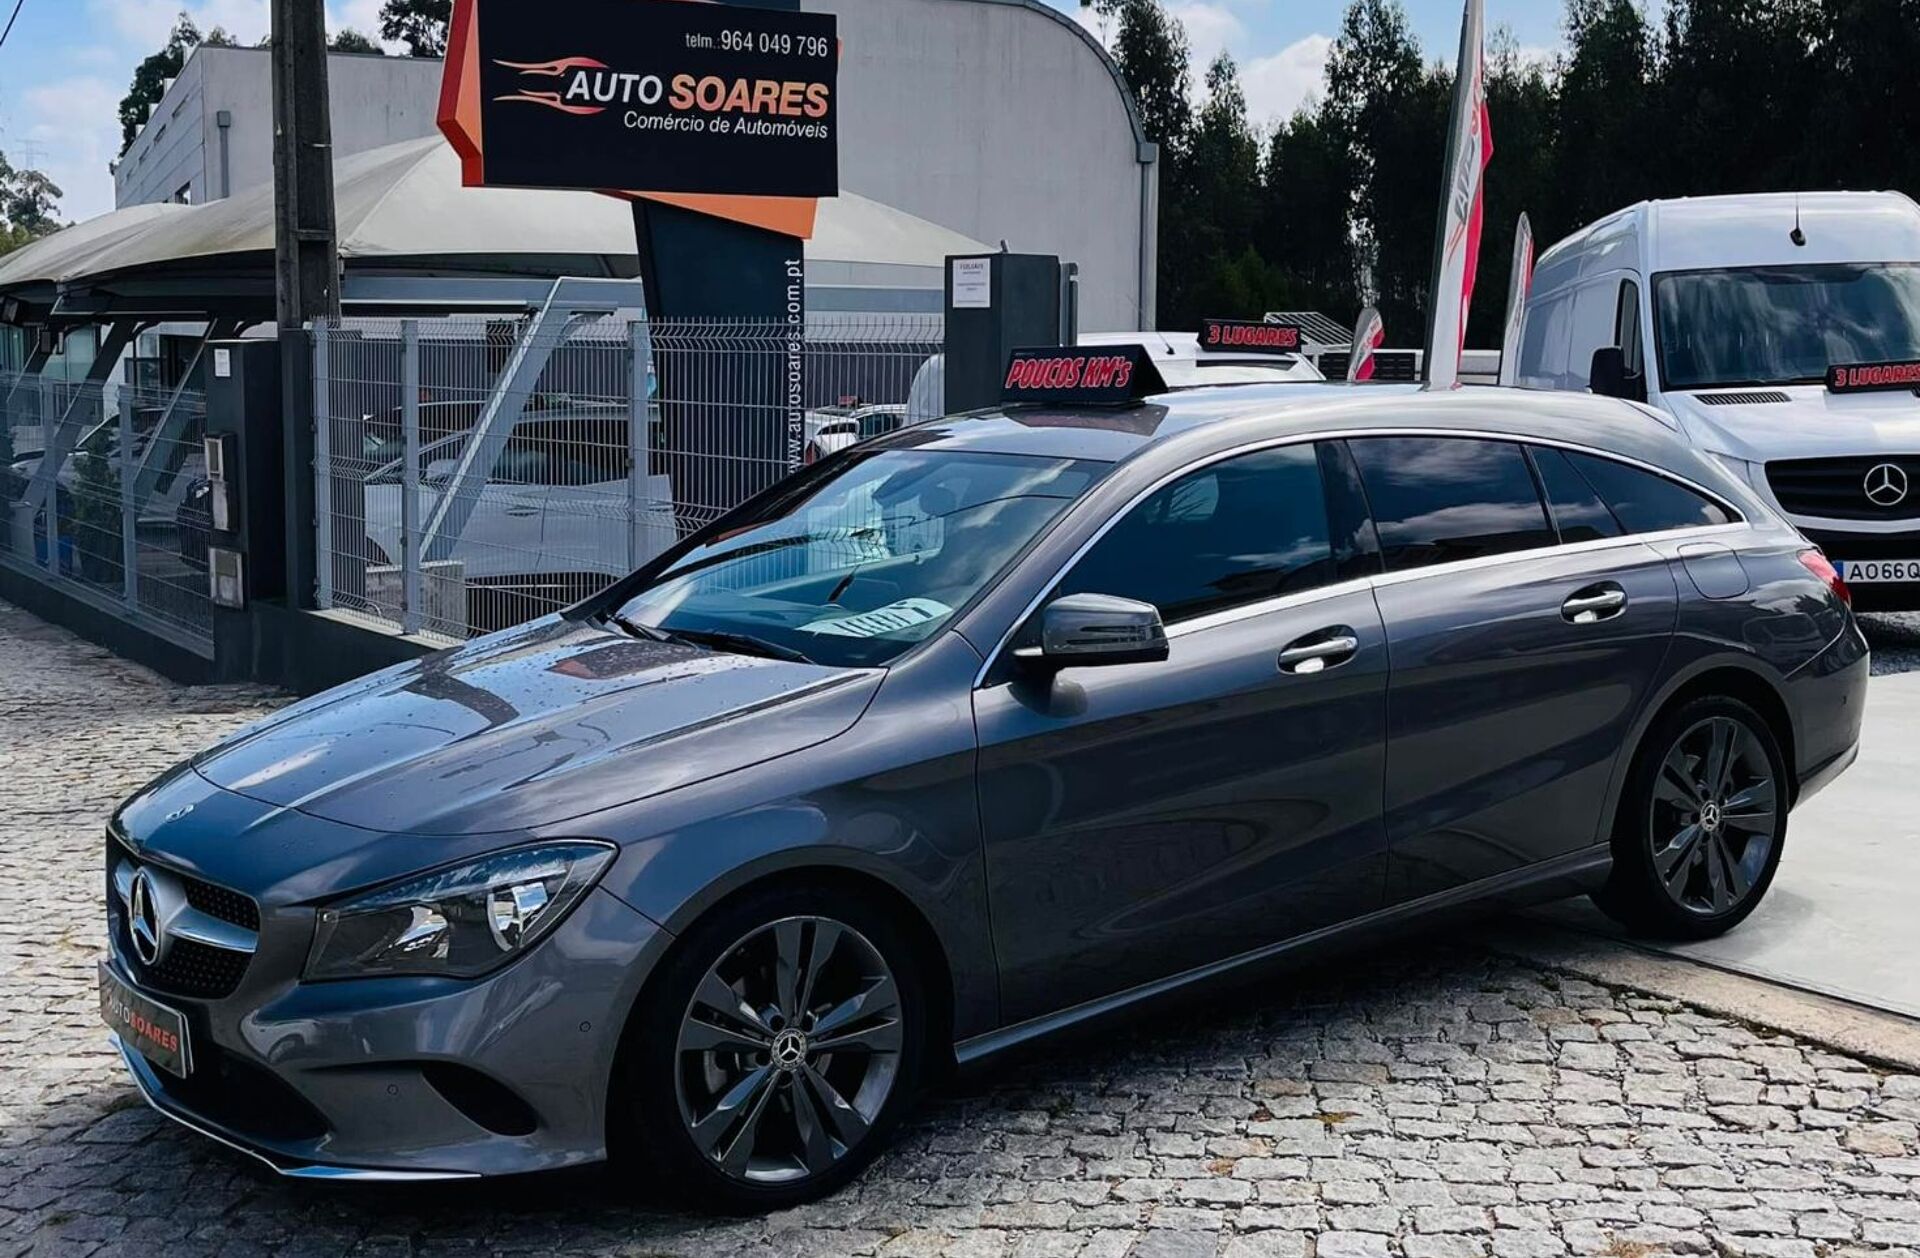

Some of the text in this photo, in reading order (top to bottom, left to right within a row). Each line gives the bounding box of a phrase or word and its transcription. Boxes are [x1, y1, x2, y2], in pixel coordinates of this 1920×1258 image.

[759, 32, 791, 54] 049
[796, 35, 828, 57] 796
[565, 70, 830, 118] AUTO SOARES
[623, 110, 829, 139] Comércio de Automóveis
[1207, 324, 1298, 347] 3 LUGARES
[1004, 355, 1133, 389] POUCOS KM's
[1834, 367, 1848, 388] 3
